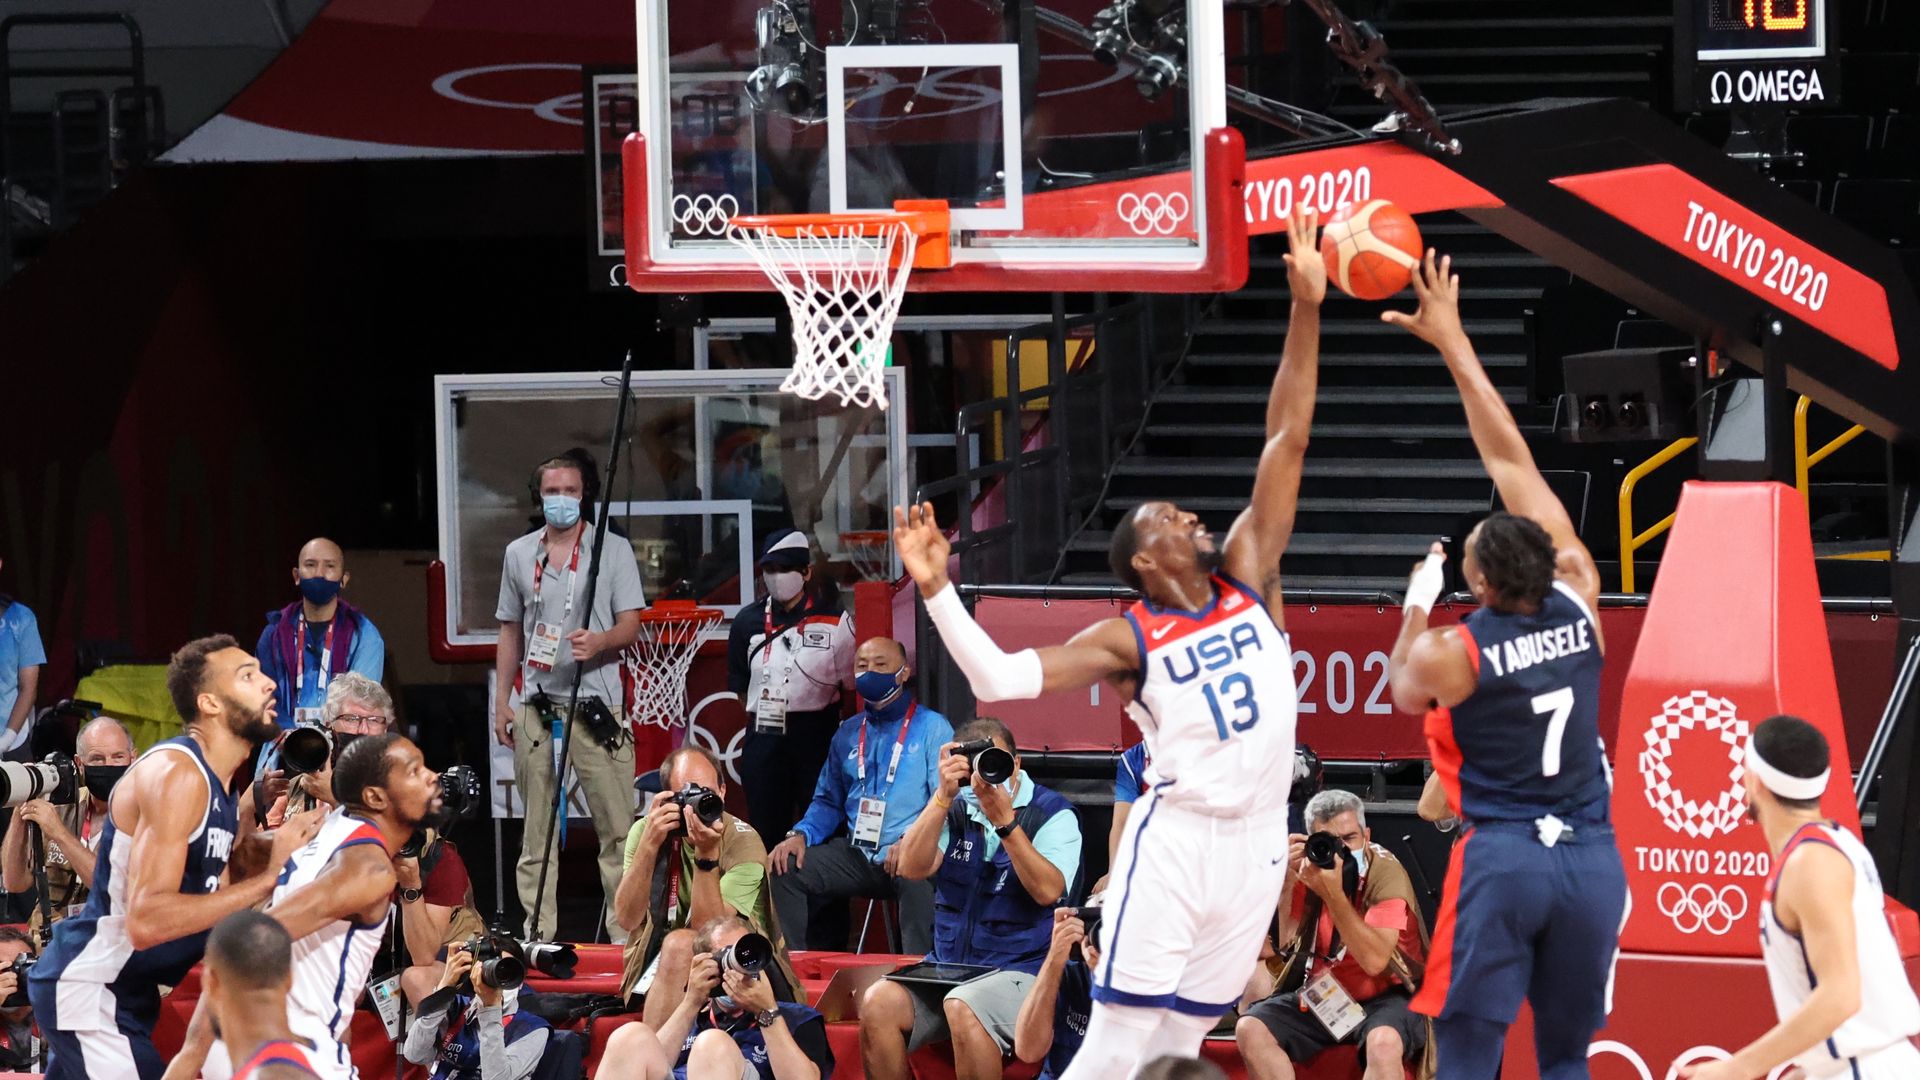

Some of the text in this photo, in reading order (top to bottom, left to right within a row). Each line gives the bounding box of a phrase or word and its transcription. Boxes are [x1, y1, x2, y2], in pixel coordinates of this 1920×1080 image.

[1737, 68, 1825, 103] OMEGA
[1244, 166, 1371, 223] KYO 2020
[1683, 200, 1829, 311] TOKYO 2020
[1163, 621, 1264, 685] USA
[1482, 617, 1591, 677] YABUSELE
[1201, 671, 1260, 742] 13
[1292, 650, 1392, 715] 202
[1531, 685, 1575, 777] 7
[1634, 846, 1770, 877] TOKYO 2020
